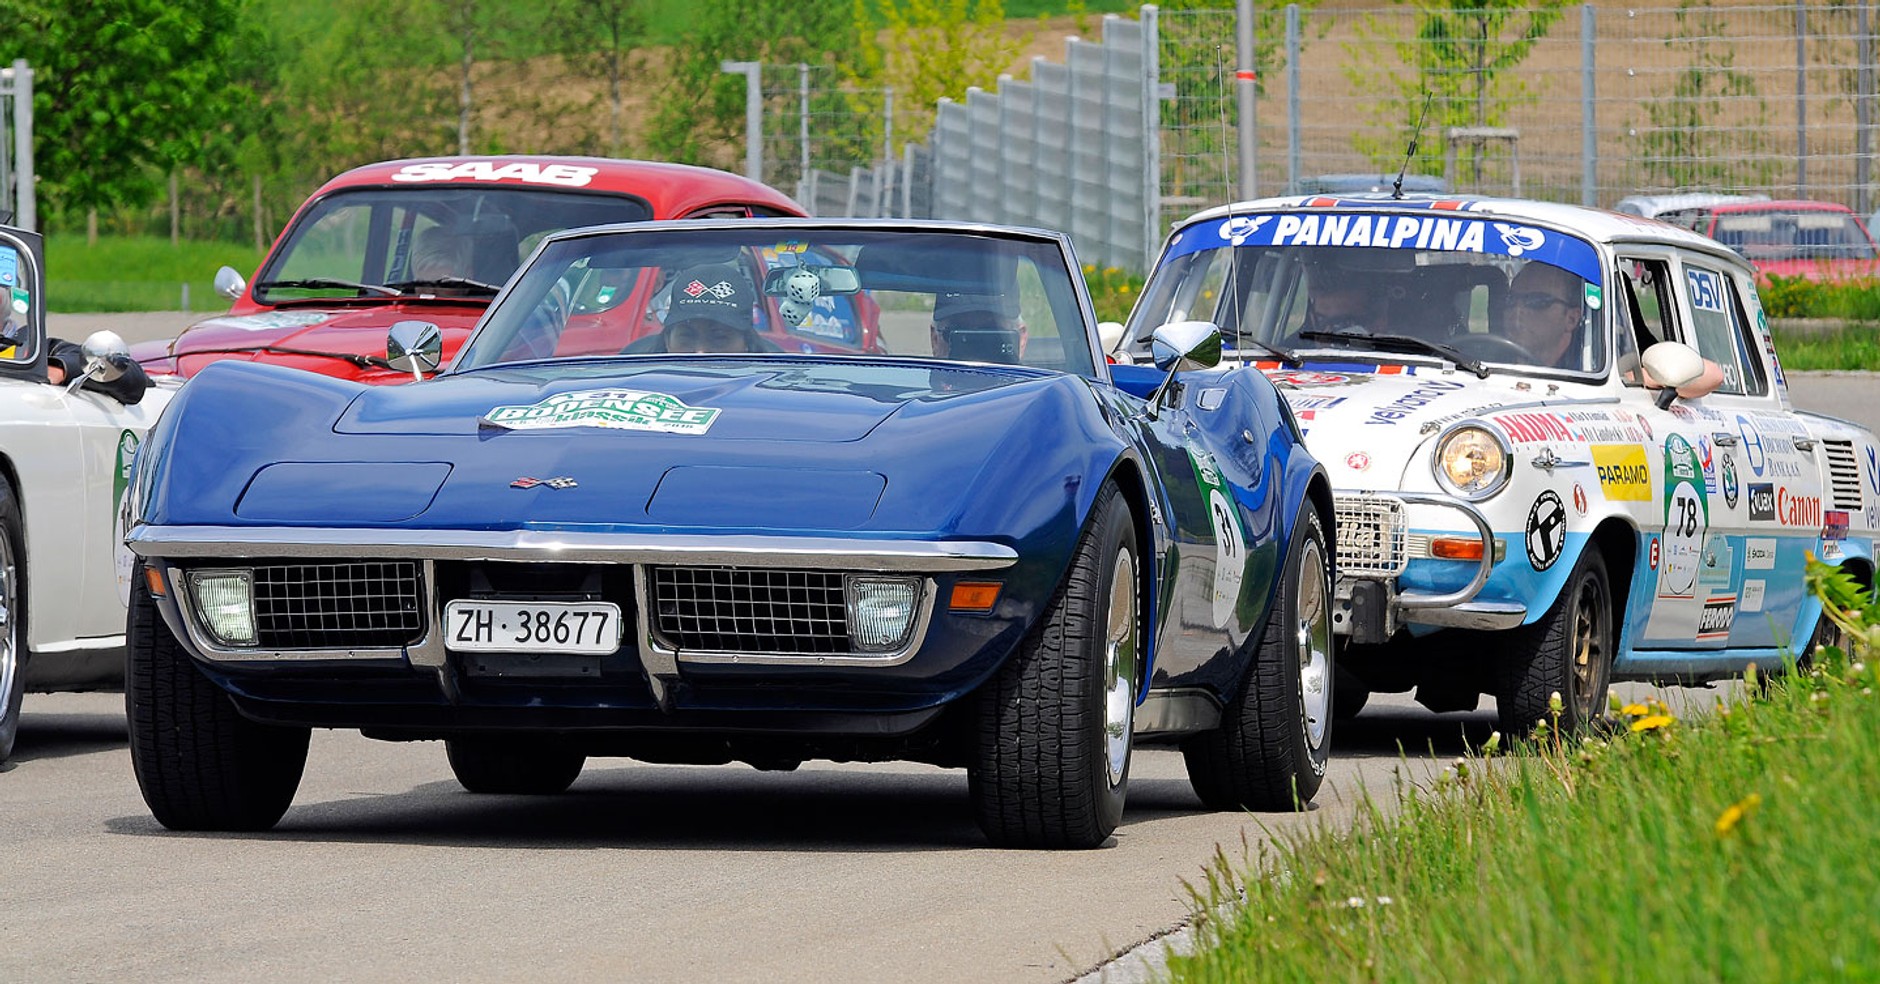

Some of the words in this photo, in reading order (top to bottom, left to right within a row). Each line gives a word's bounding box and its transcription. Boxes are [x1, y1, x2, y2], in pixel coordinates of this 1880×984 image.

[391, 161, 599, 187] SAAB
[1271, 215, 1486, 252] PANALPINA
[679, 299, 737, 307] CORVETTE
[1688, 270, 1721, 310] DSV
[500, 399, 709, 421] BODENSEE
[1493, 413, 1574, 444] AKUMA
[1597, 465, 1648, 485] PARAMO
[1676, 496, 1697, 538] 78
[1778, 486, 1821, 527] Canon
[1214, 503, 1236, 558] 31
[456, 609, 493, 643] ZH
[514, 610, 609, 645] 38677
[1700, 606, 1734, 629] FERODO
